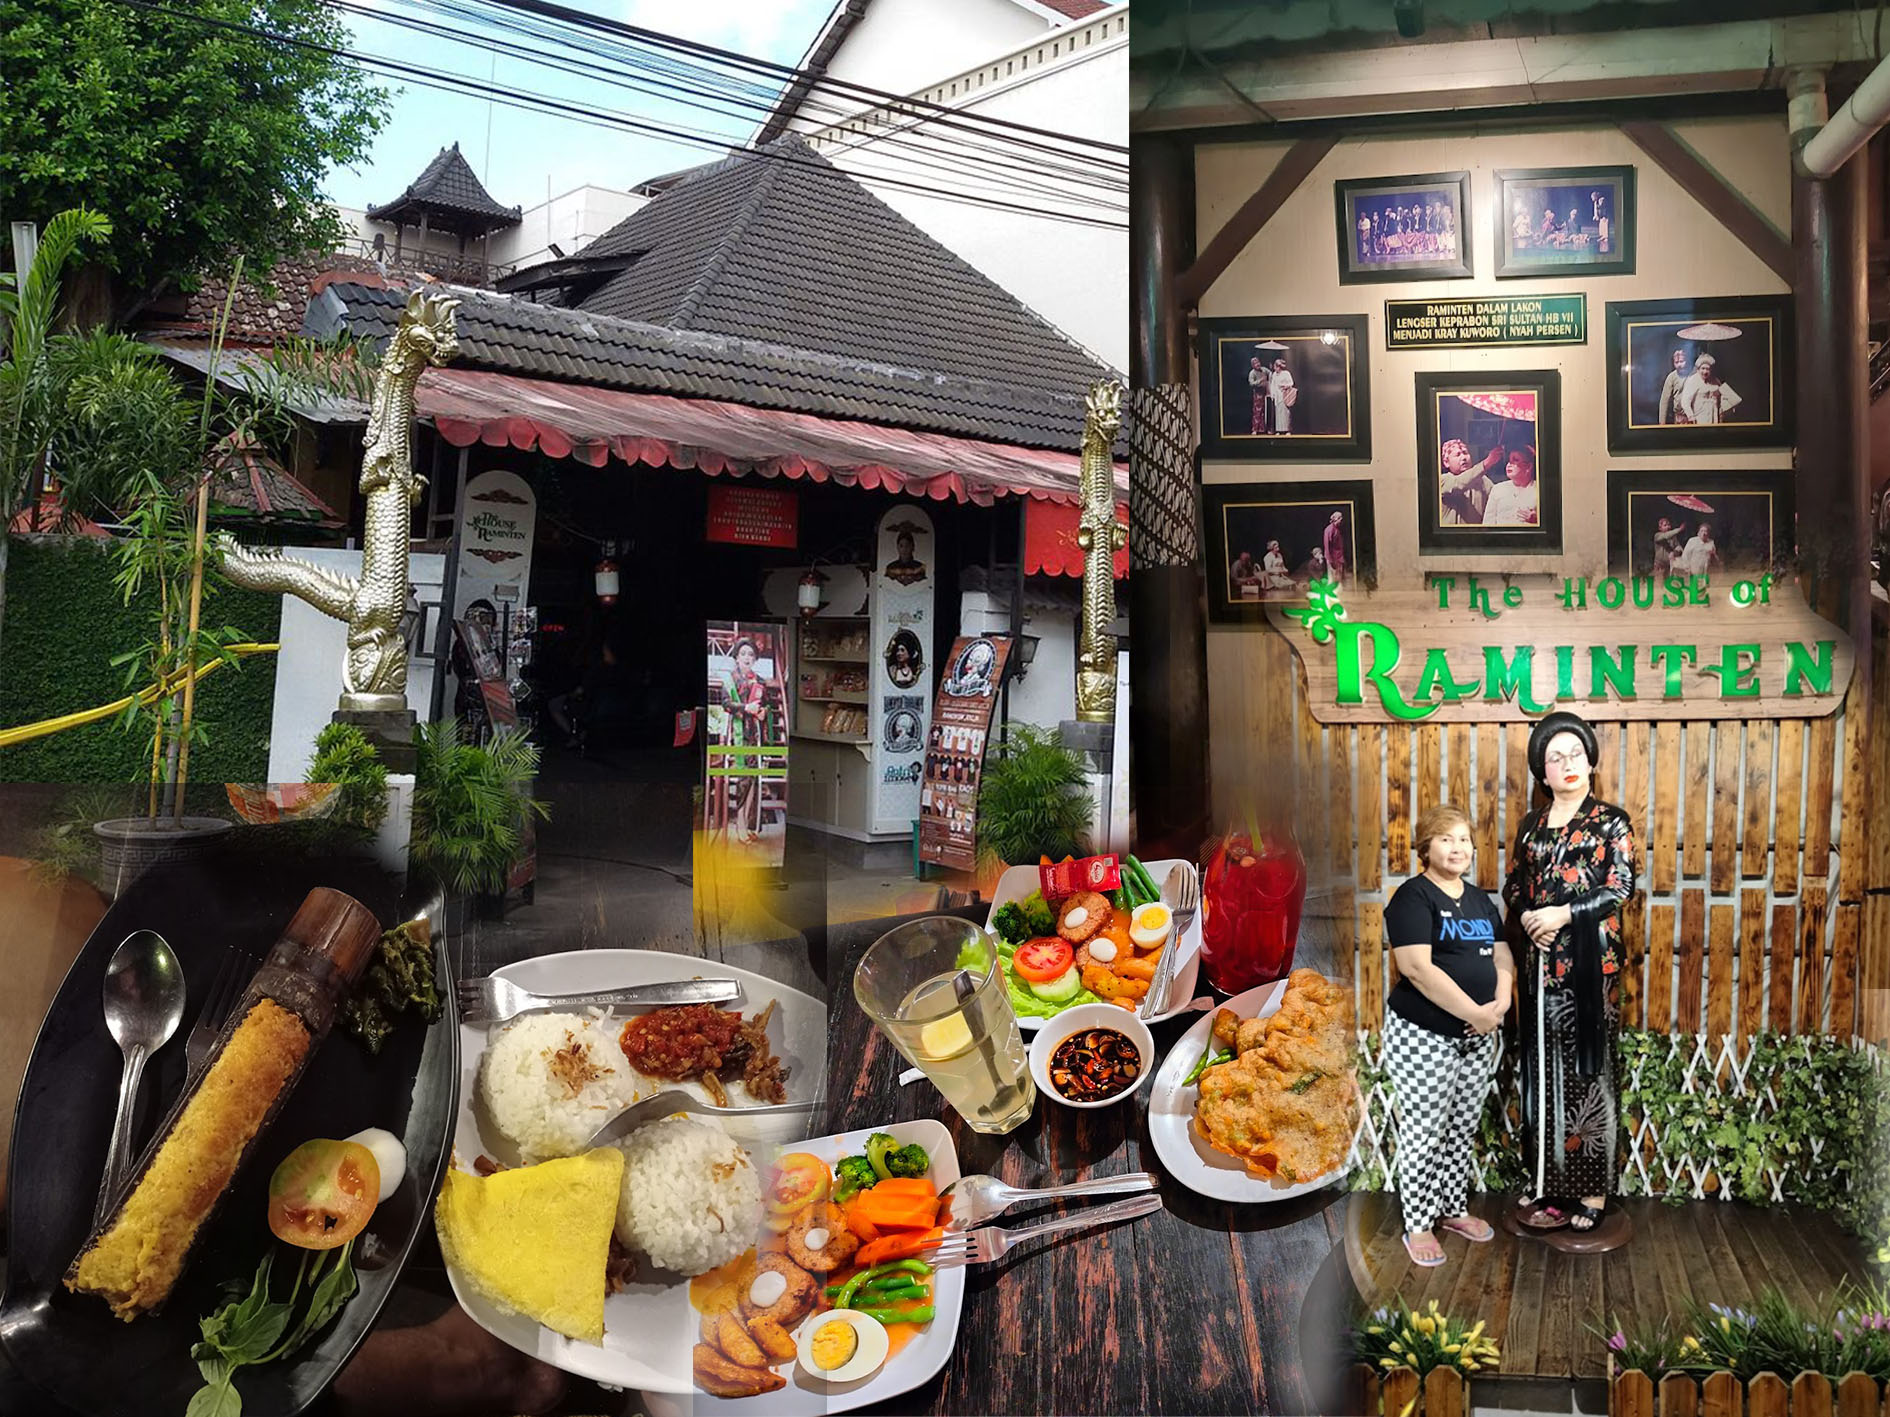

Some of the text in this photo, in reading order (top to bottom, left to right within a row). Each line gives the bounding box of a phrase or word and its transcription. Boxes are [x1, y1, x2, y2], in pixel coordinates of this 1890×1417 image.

[1427, 302, 1542, 316] RAMINTEN DALAM LAKON
[1396, 311, 1574, 329] LENGSER KEPRABON SRI SULTAN HB VII
[1393, 328, 1432, 340] MENJADI
[1434, 327, 1458, 339] KRAY
[1460, 326, 1501, 339] KUWORO
[1509, 325, 1534, 337] NYAH
[1536, 324, 1572, 336] PERSEN
[478, 527, 527, 542] RAMINTEN
[1431, 572, 1775, 619] The HOUSE of
[1334, 621, 1837, 721] RAMINTEN
